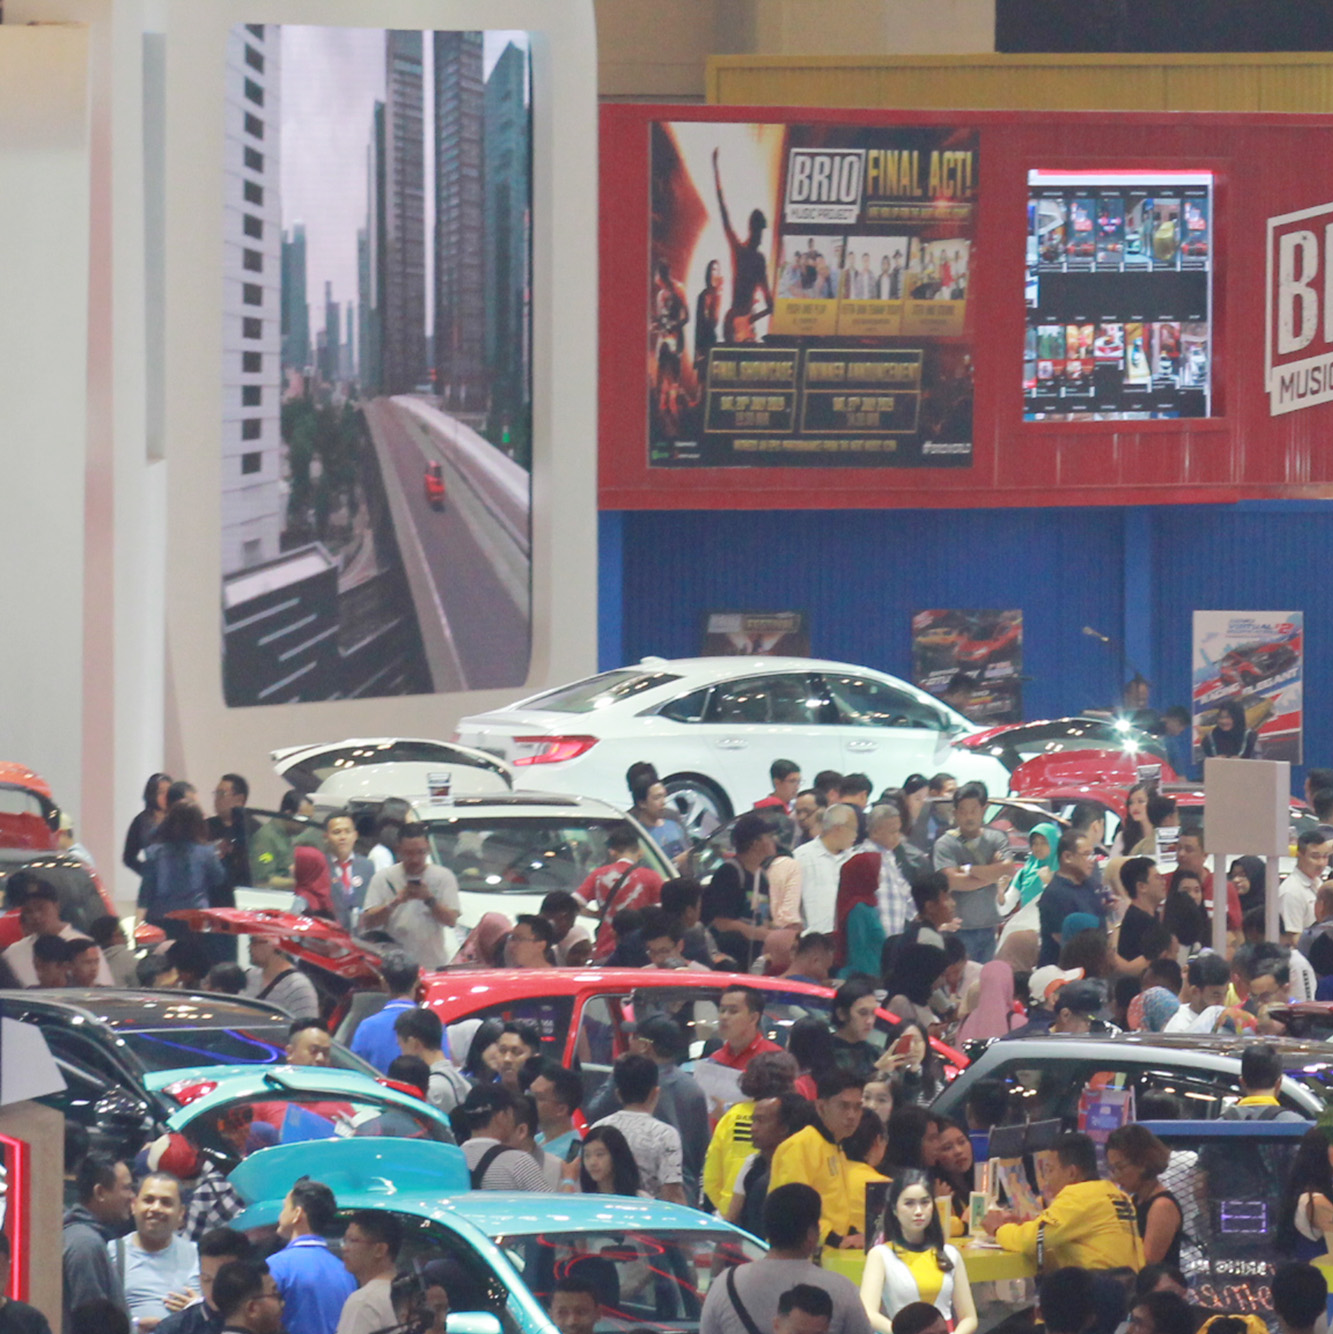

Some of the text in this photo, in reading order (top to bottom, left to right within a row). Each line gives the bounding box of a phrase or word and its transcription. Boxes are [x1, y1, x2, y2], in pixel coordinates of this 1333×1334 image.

[791, 155, 861, 202] BRIO
[867, 150, 973, 197] FINAL ACT!
